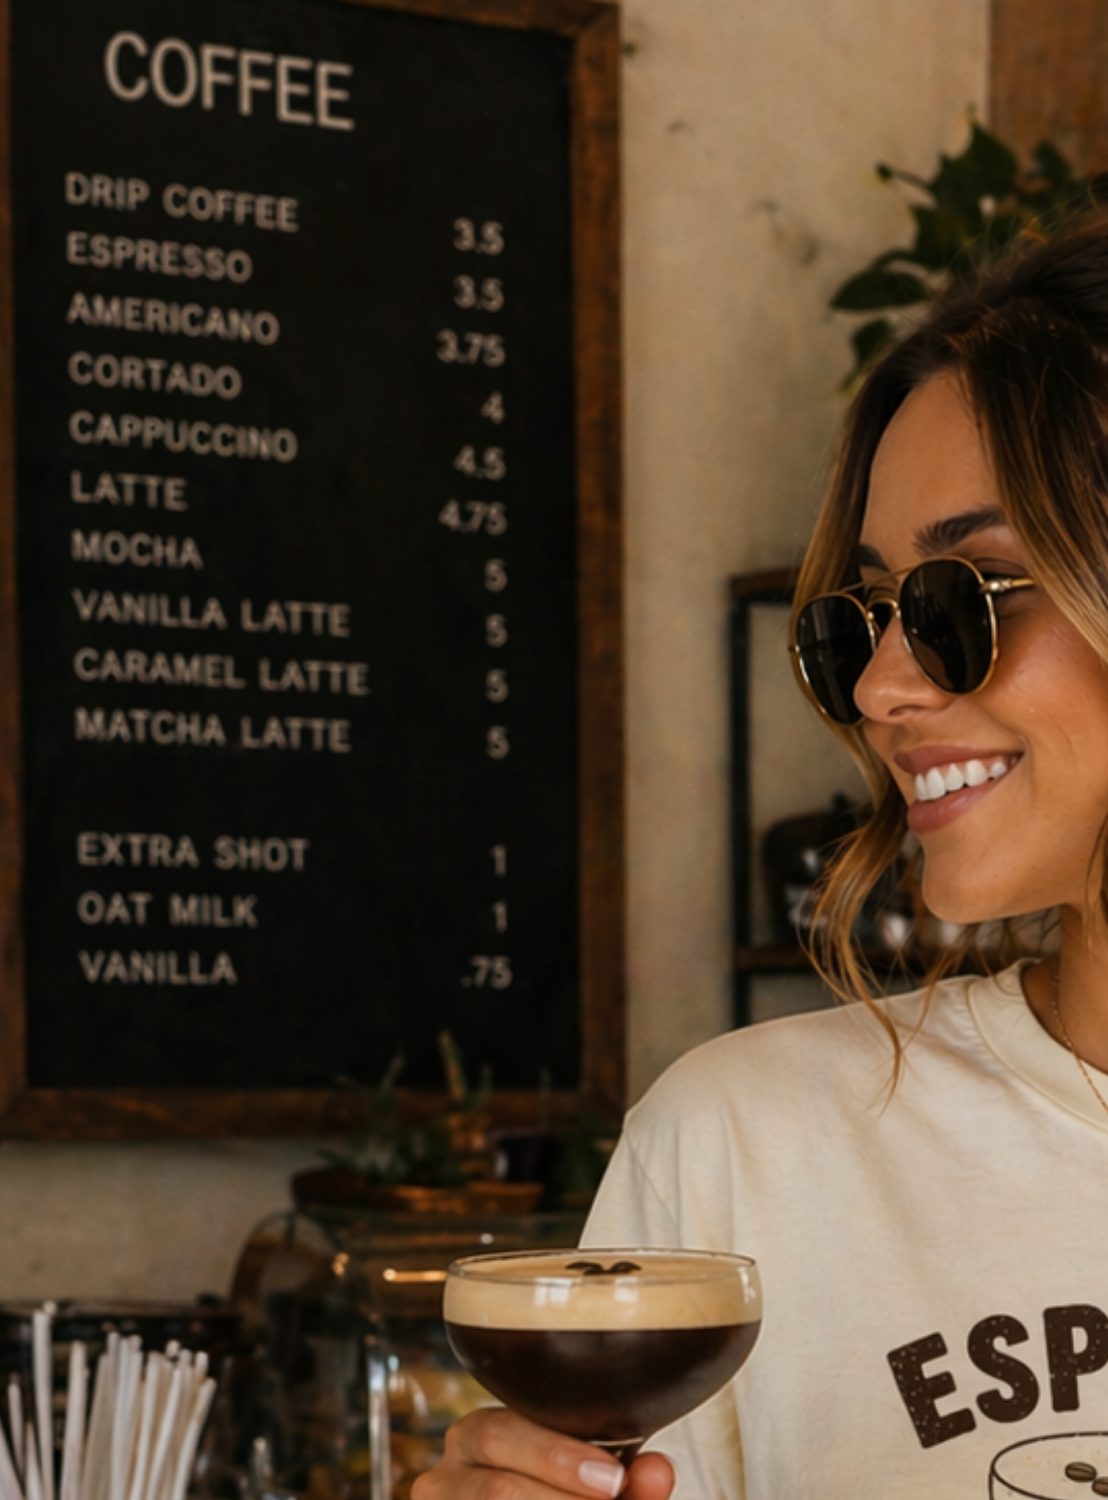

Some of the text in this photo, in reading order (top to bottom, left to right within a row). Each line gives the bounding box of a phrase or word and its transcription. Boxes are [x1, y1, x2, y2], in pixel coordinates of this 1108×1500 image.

[103, 30, 356, 132] COFFEE
[64, 171, 503, 256] DRIP COFFEE 3.5
[66, 230, 503, 313] ESPRESSO 3.5
[66, 291, 505, 368] AMERICANO 3.75
[68, 350, 504, 424] CORTADO 4
[68, 409, 505, 481] CAPPUCCINO 4.5
[70, 470, 507, 535] LATTE 4.75
[71, 529, 507, 592] MOCHA 5
[71, 588, 508, 648] VANILLA LATTE 5
[73, 647, 509, 703] CARAMEL LATTE 5
[74, 706, 510, 760] MATCHA LATTE 5
[76, 830, 507, 877] EXTRA SHOT 1
[76, 891, 508, 933] OAT MILK 1
[79, 950, 512, 989] VANILLA .75
